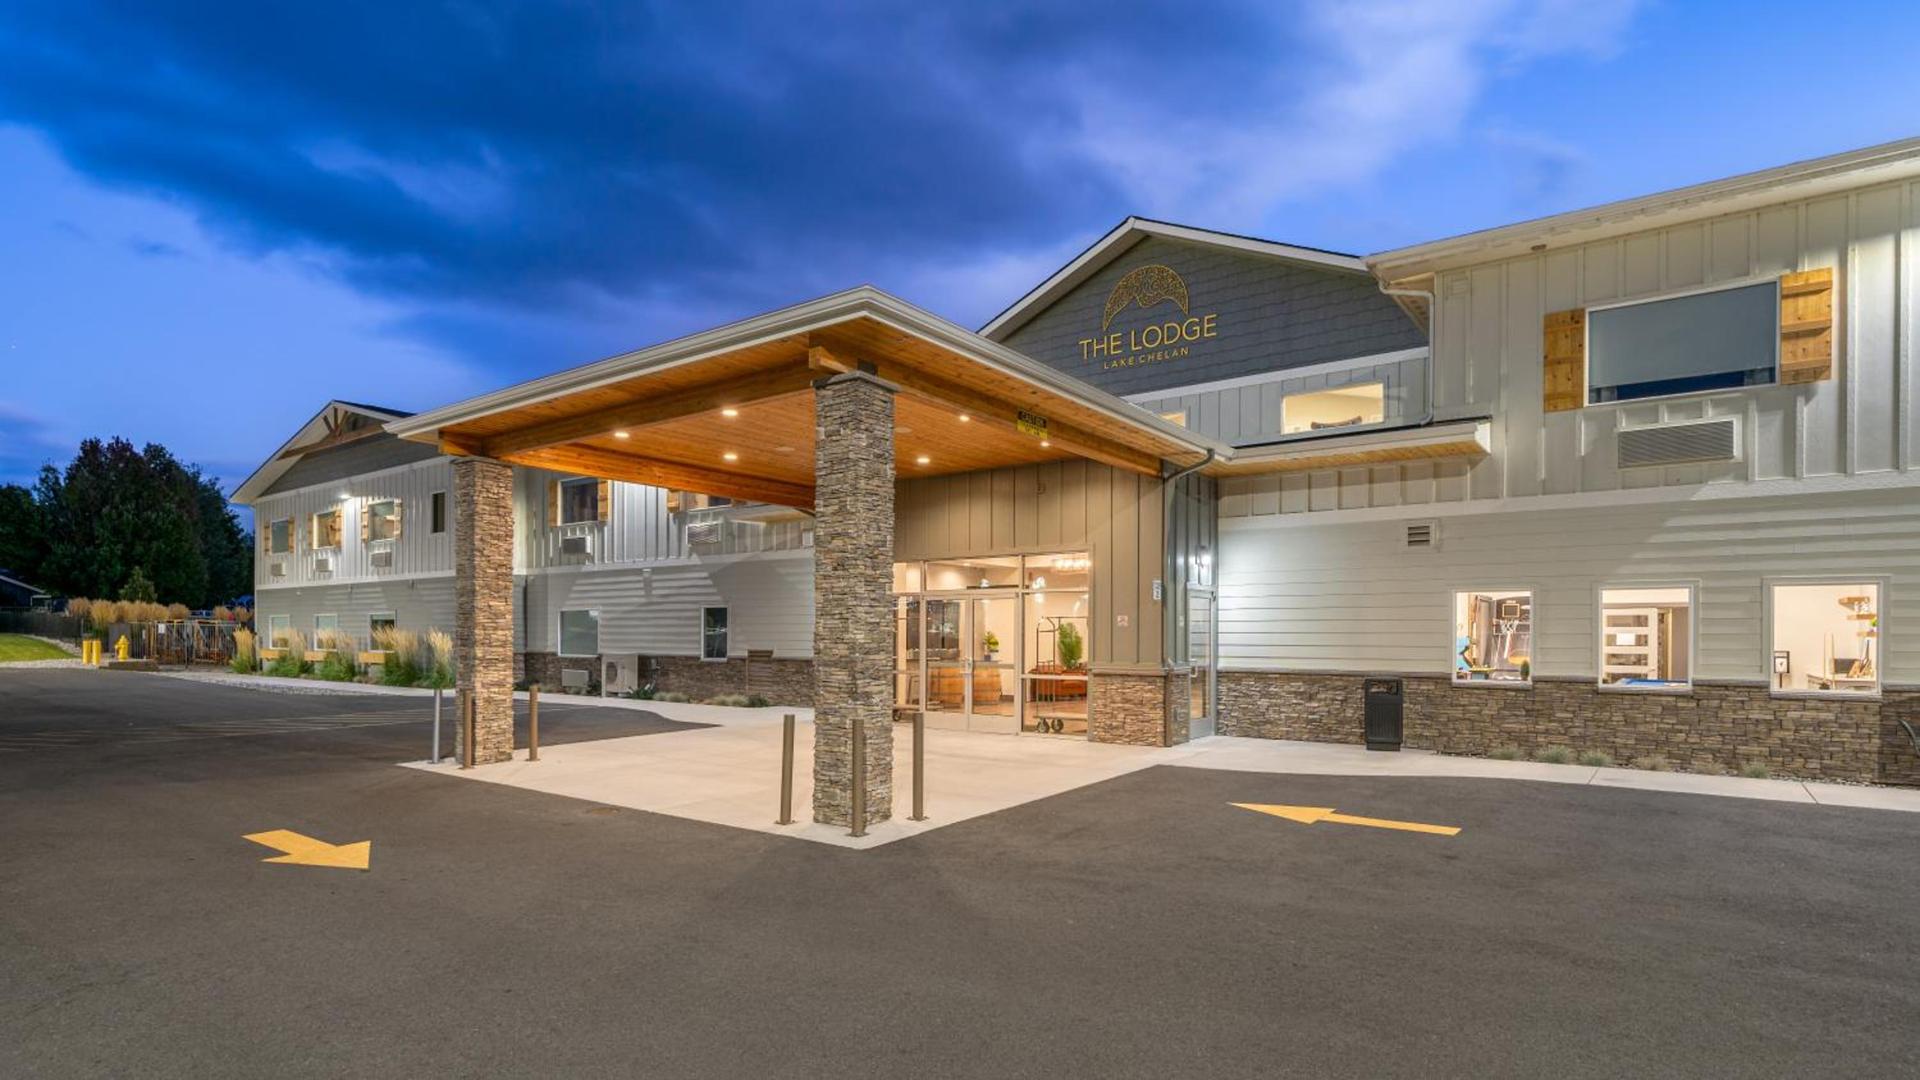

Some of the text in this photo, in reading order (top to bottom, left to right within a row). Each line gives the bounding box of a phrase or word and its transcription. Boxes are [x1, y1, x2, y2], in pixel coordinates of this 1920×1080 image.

[1078, 314, 1217, 360] THE LODGE
[1104, 346, 1189, 370] LAKE CHELAN
